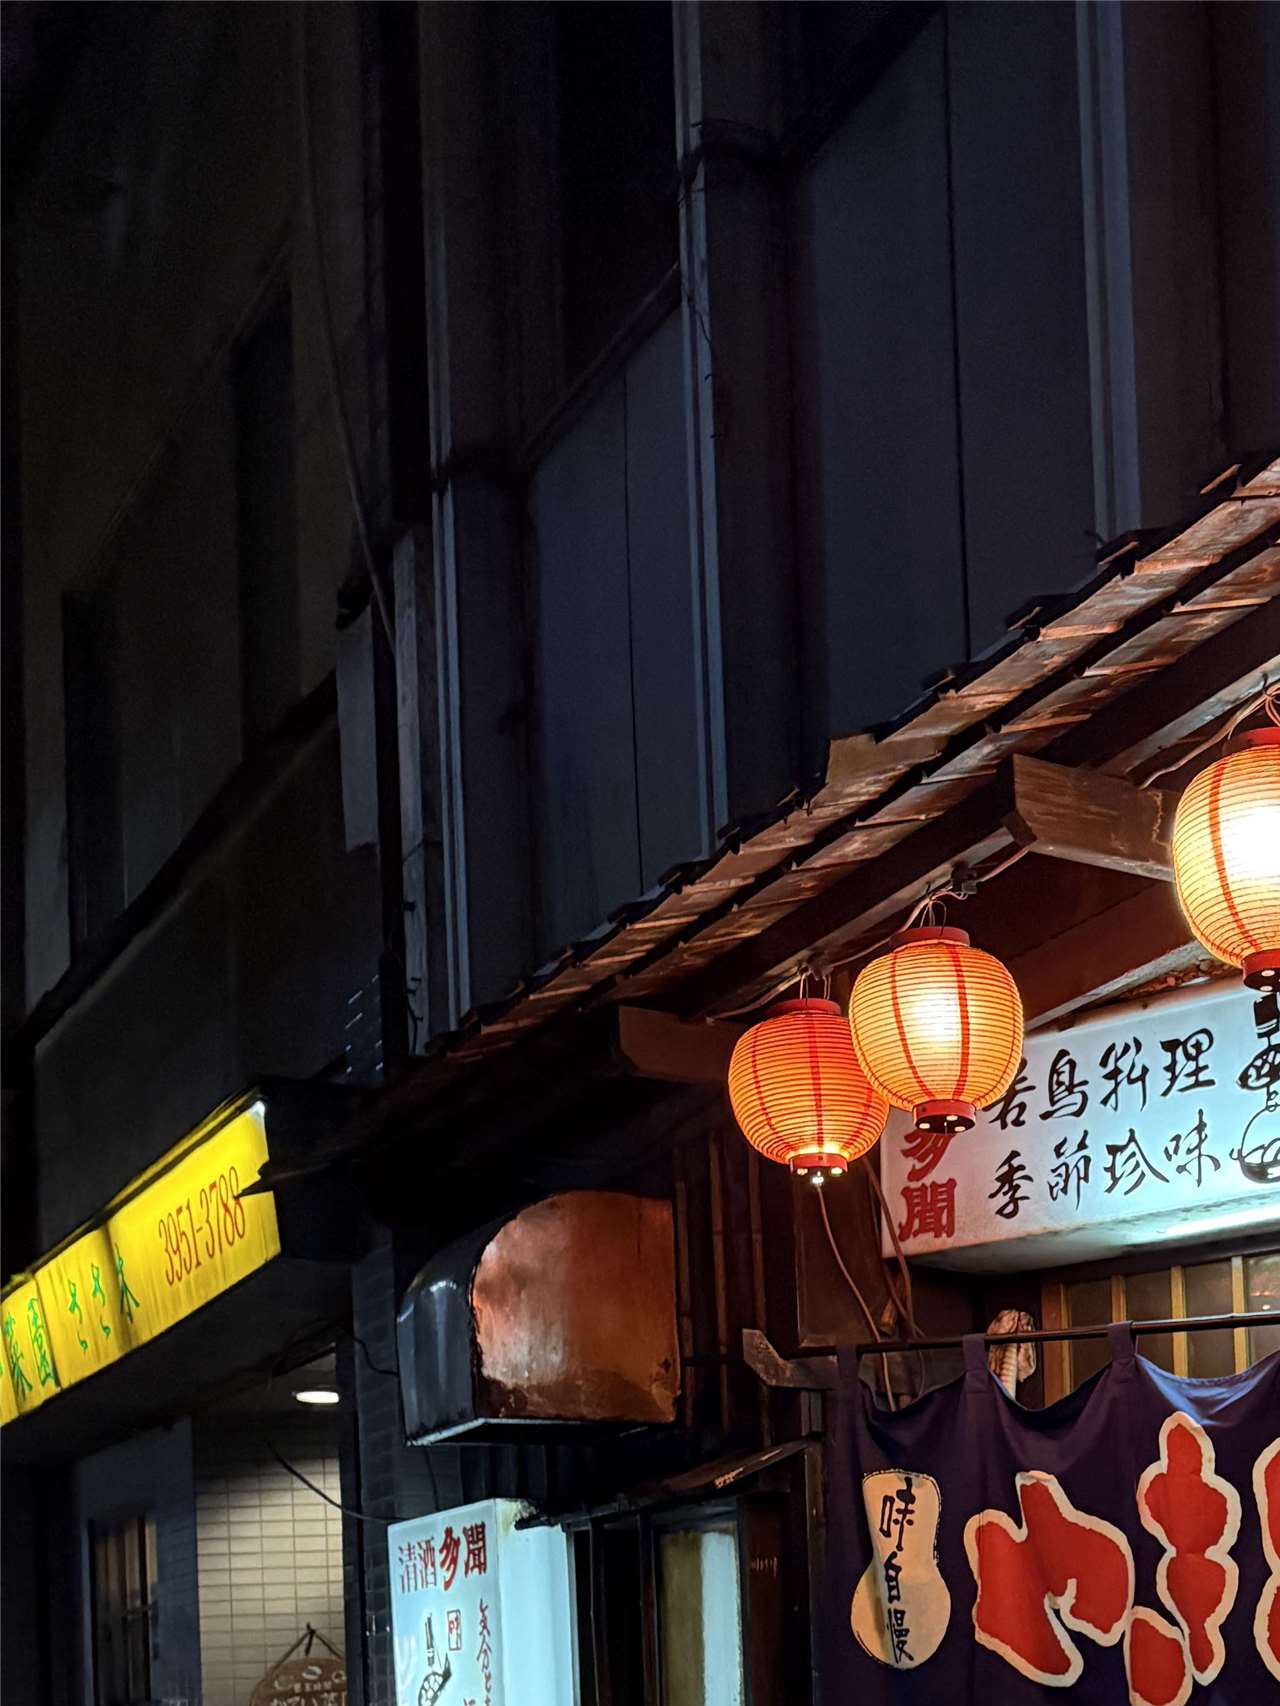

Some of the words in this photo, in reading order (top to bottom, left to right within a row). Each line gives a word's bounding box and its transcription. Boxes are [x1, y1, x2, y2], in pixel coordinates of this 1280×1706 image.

[988, 1109, 1221, 1220] 季節珍味
[158, 1166, 246, 1287] 3951-3788
